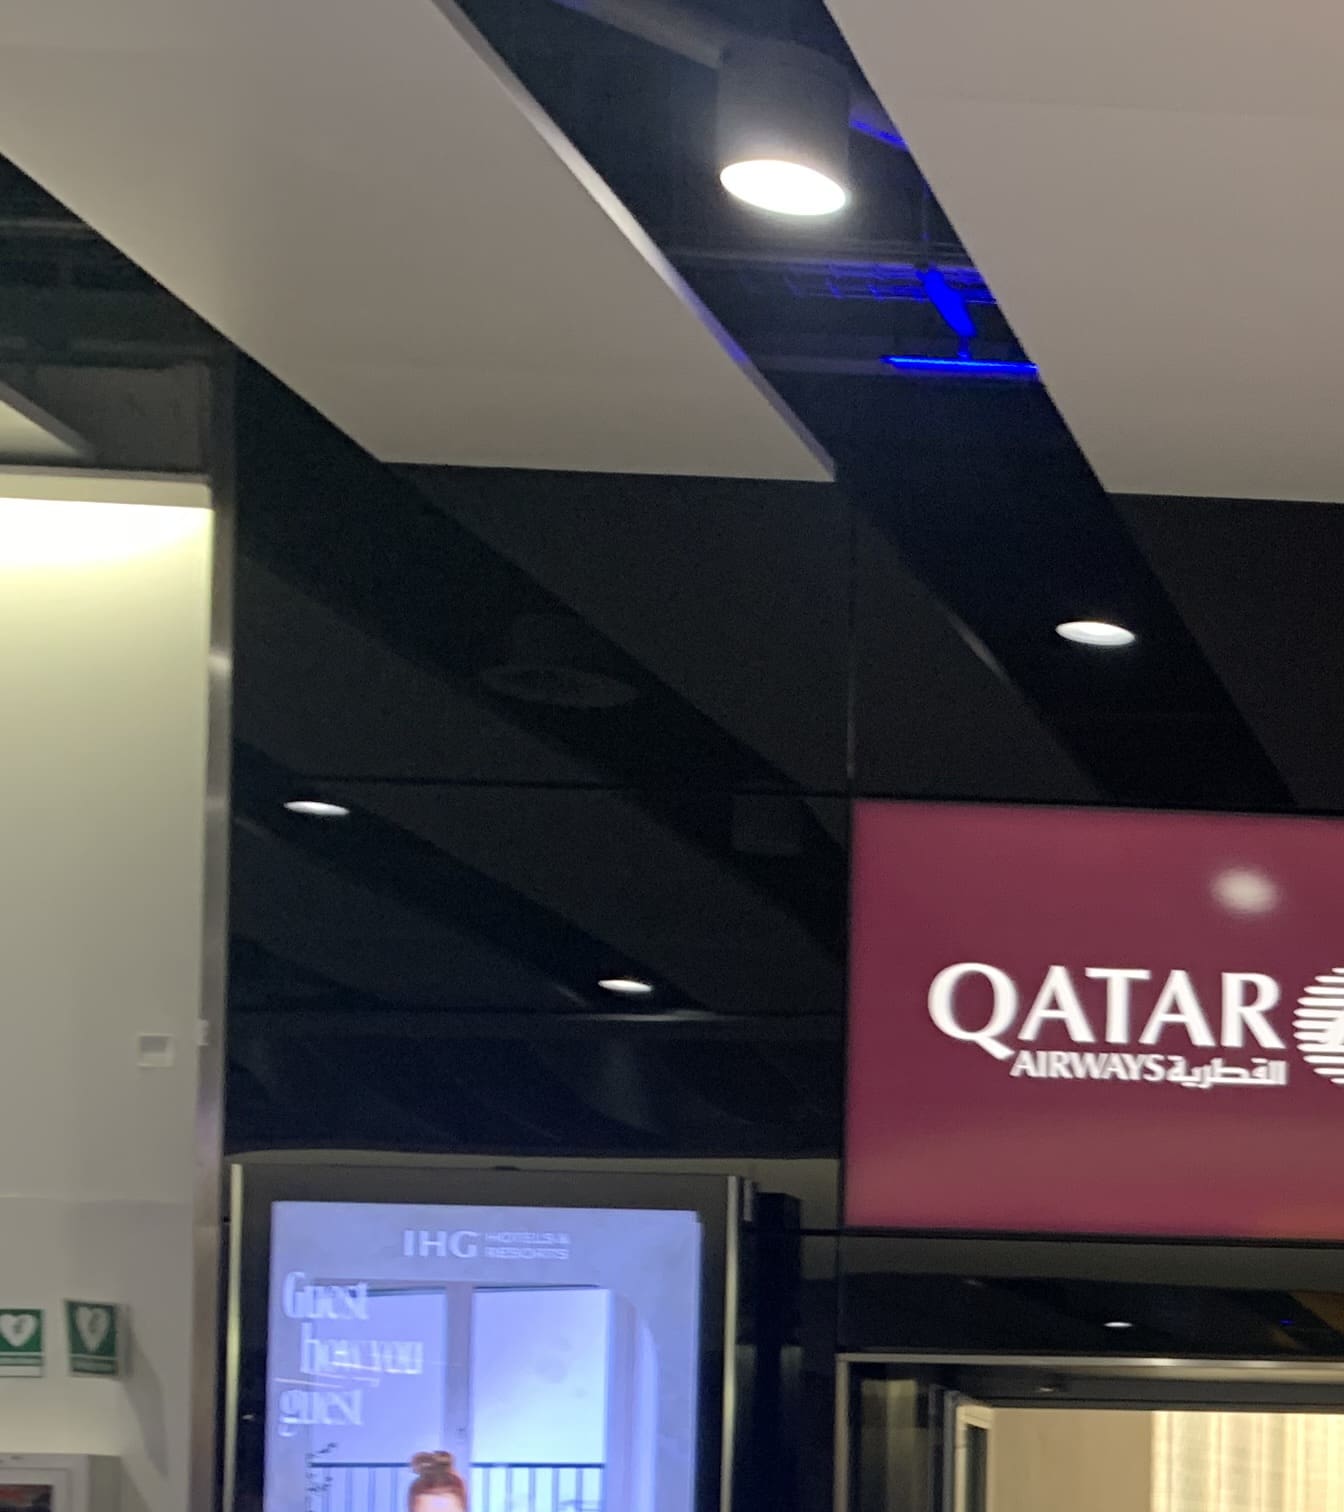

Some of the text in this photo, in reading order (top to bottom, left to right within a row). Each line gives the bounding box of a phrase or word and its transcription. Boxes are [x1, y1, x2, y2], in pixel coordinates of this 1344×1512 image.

[927, 962, 1286, 1060] QATAR
[1009, 1051, 1166, 1081] AIRWAYS
[1165, 1055, 1287, 1088] القطرية
[403, 1229, 479, 1258] IHG
